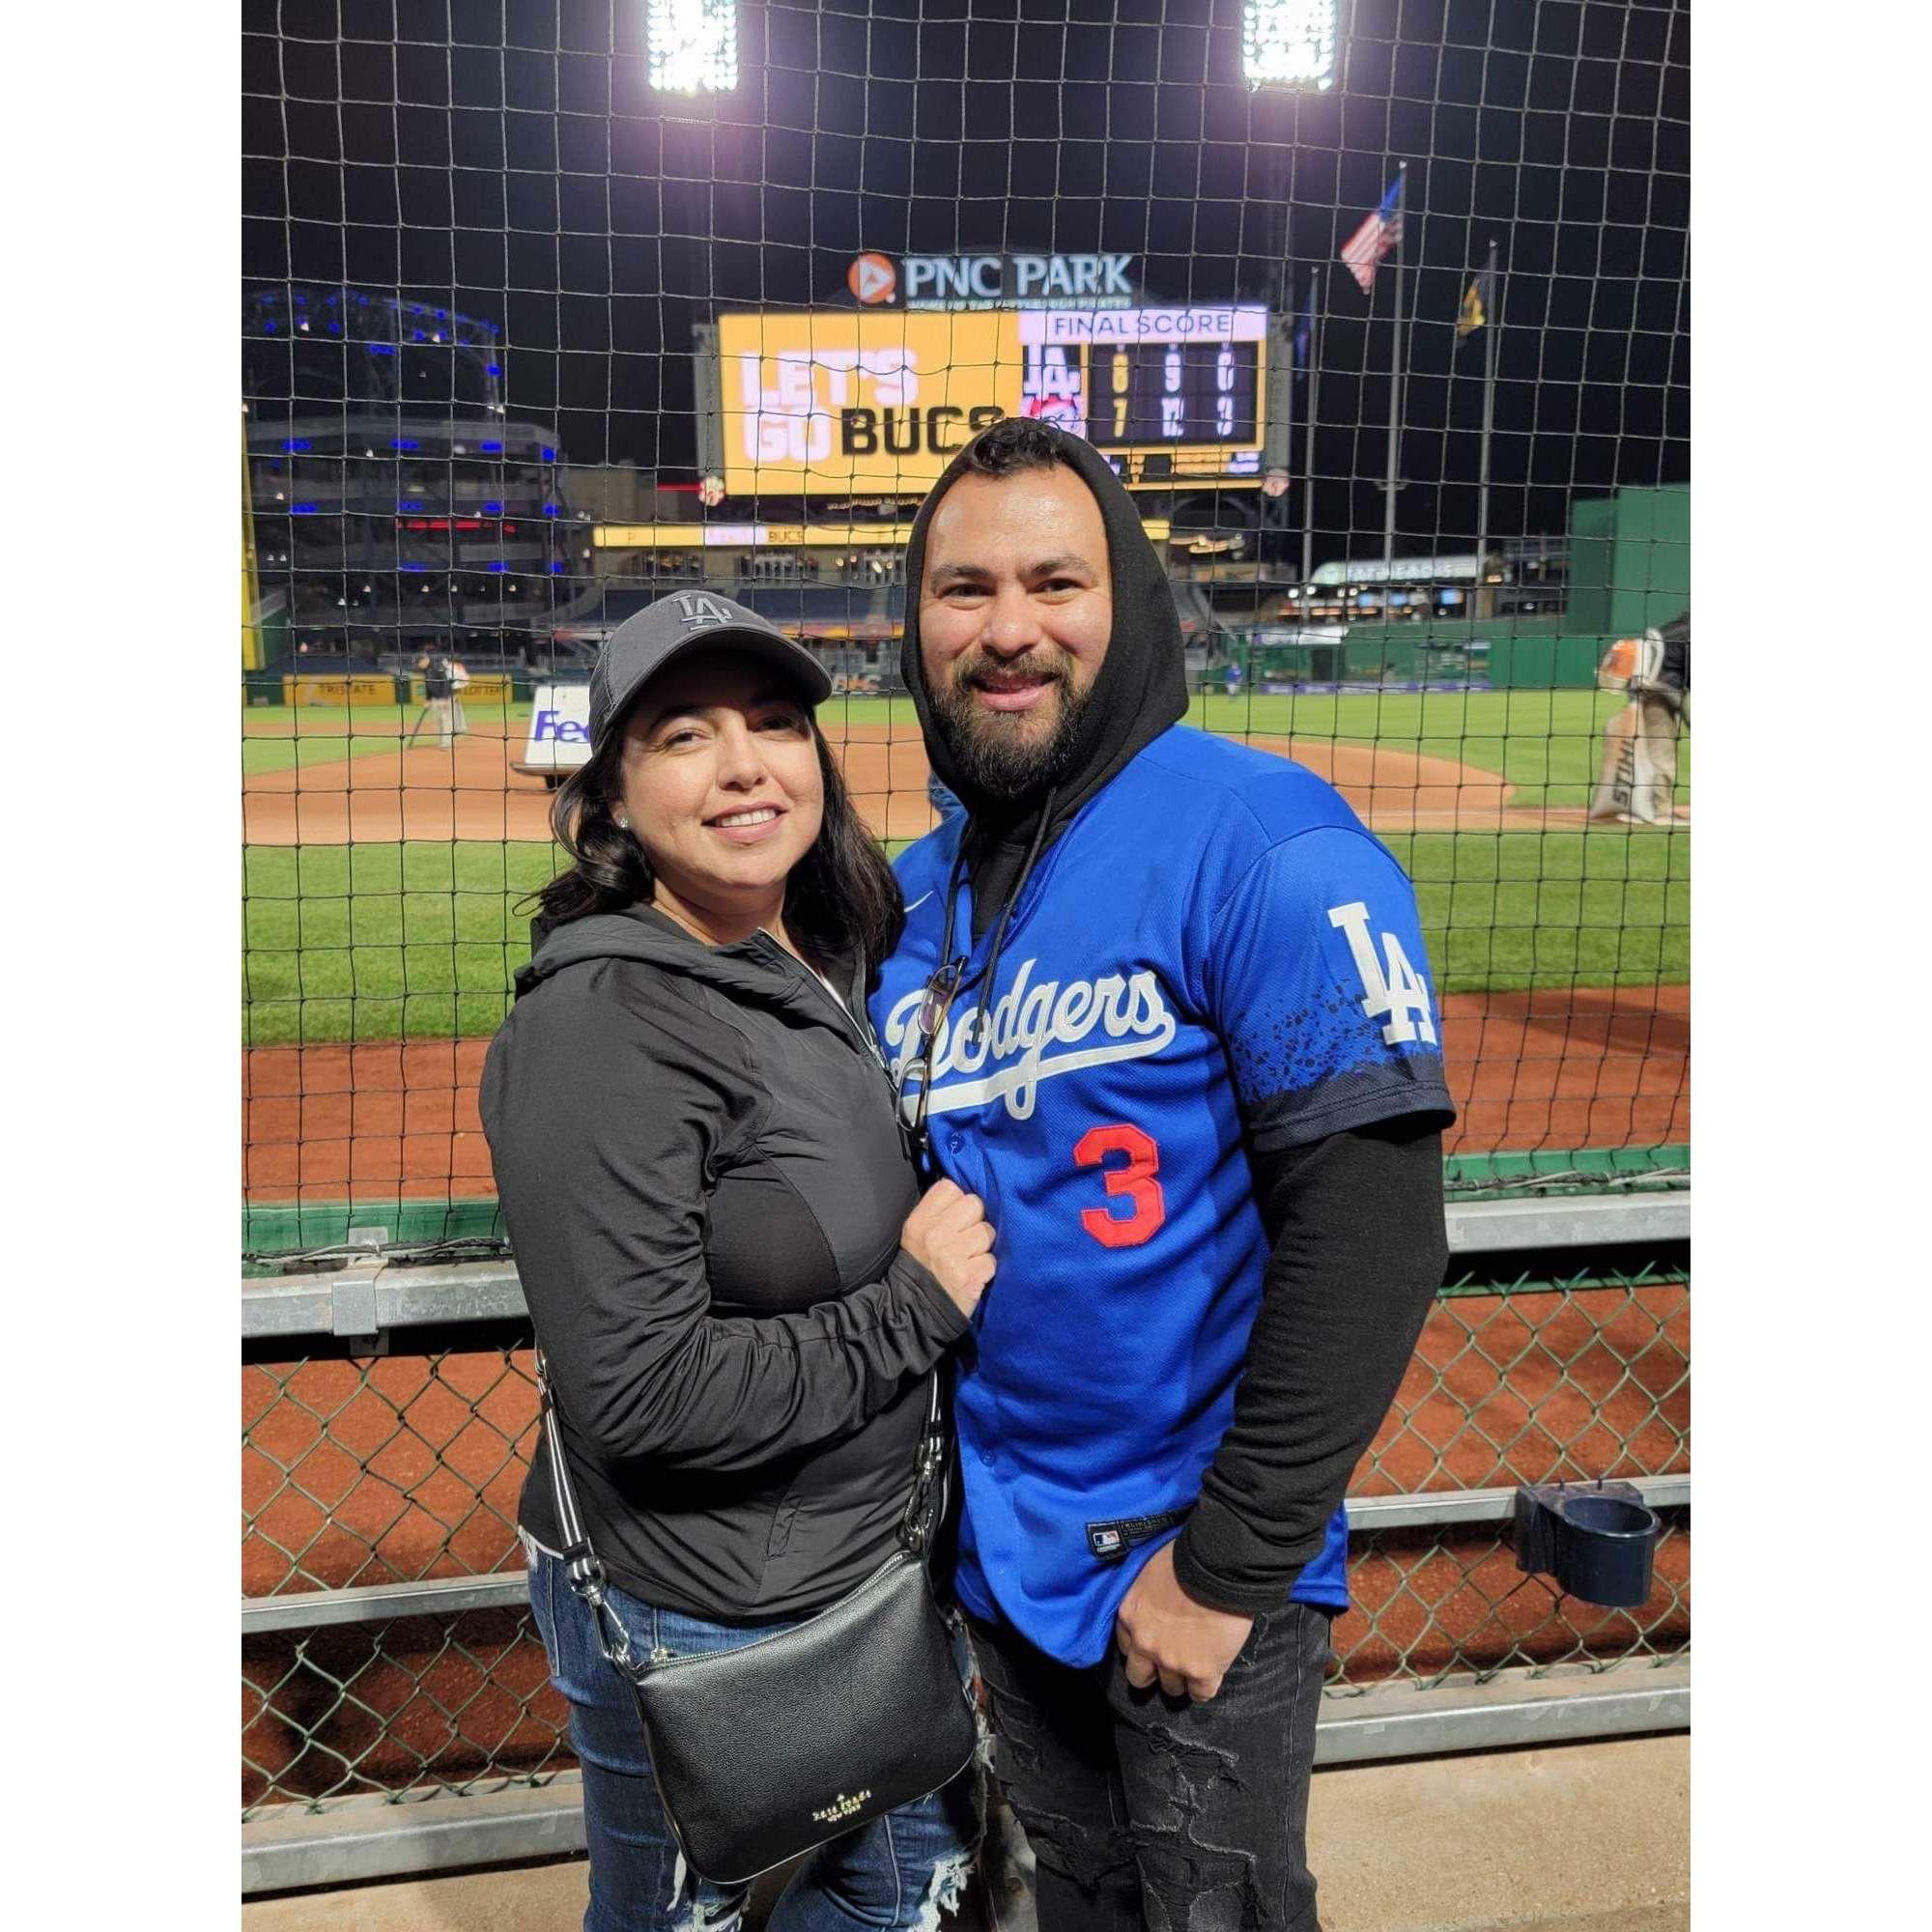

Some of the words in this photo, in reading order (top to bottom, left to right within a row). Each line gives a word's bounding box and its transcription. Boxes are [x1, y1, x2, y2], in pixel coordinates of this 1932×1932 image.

[904, 256, 1002, 298] PNC
[1012, 254, 1133, 296] PARK
[1055, 316, 1129, 335] FINAL
[1137, 314, 1230, 334] SCORE
[742, 348, 919, 407] LET'S
[744, 407, 832, 463] GO
[672, 594, 733, 631] LA
[1328, 901, 1437, 1047] LA
[883, 958, 1177, 1121] Dodgers
[1073, 1123, 1165, 1248] 3
